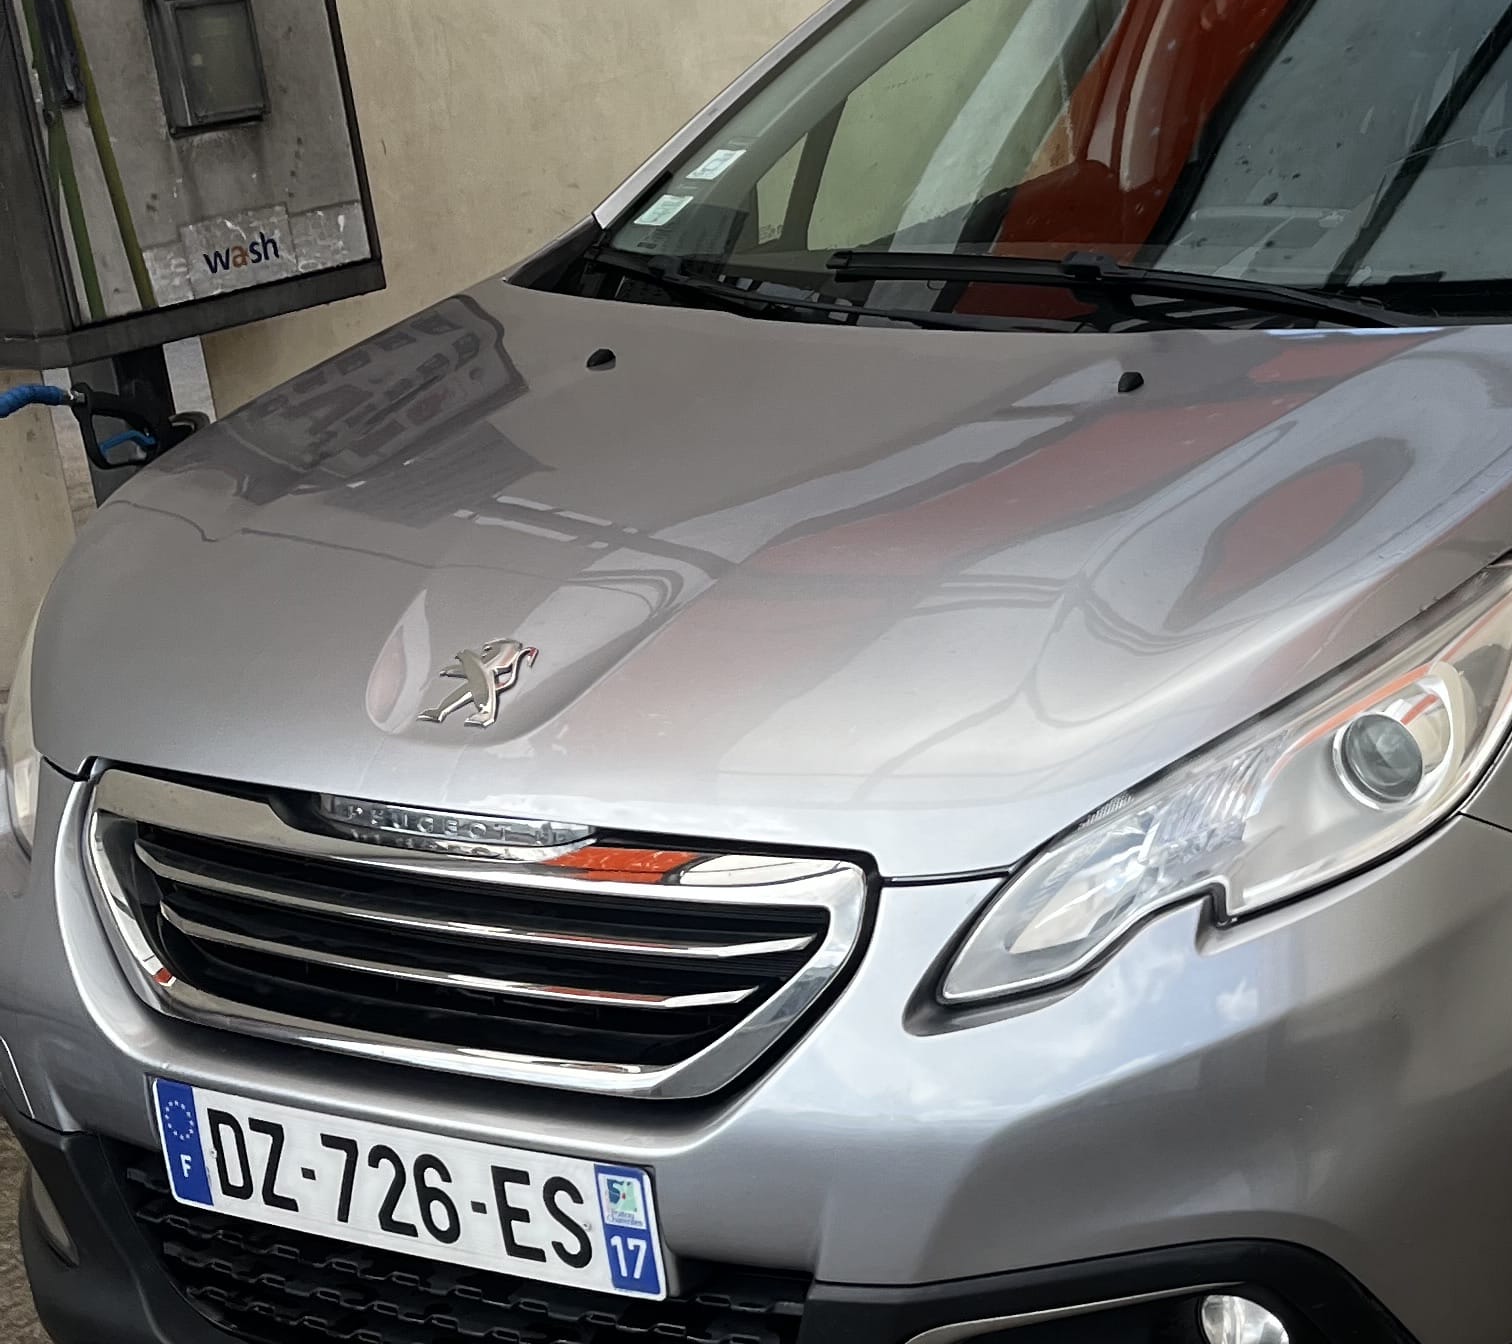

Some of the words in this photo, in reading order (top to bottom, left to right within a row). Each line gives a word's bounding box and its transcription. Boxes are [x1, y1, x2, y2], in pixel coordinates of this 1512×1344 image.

[203, 231, 279, 274] wash
[180, 1154, 192, 1178] F
[207, 1107, 593, 1269] DZ-726-ES
[610, 1235, 648, 1280] 17
